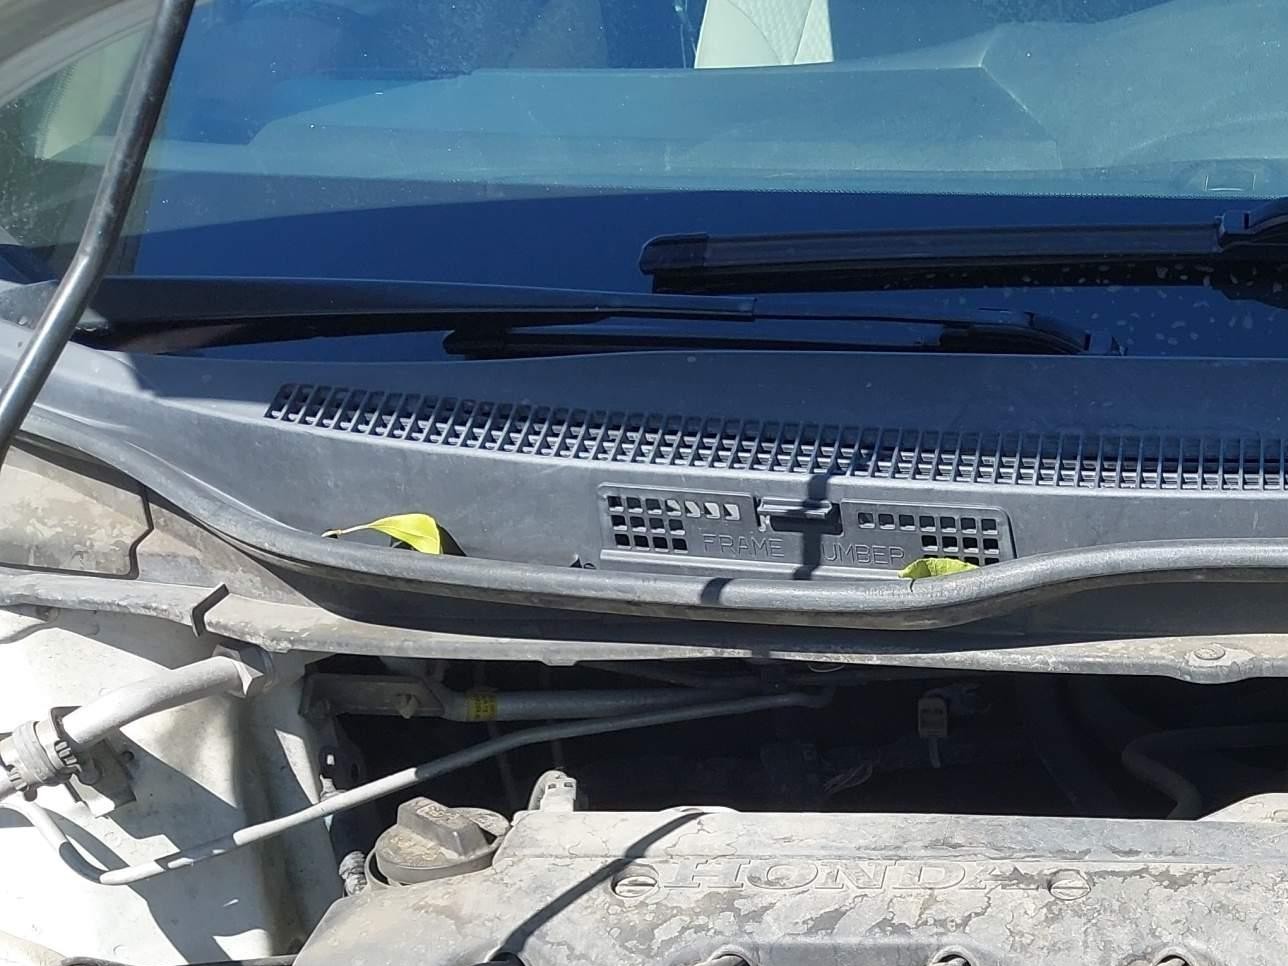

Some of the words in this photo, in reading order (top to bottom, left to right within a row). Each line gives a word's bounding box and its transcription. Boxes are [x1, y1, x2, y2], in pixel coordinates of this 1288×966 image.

[702, 533, 785, 558] FRAME
[808, 542, 906, 566] UMBER
[661, 857, 1041, 892] HONDA
